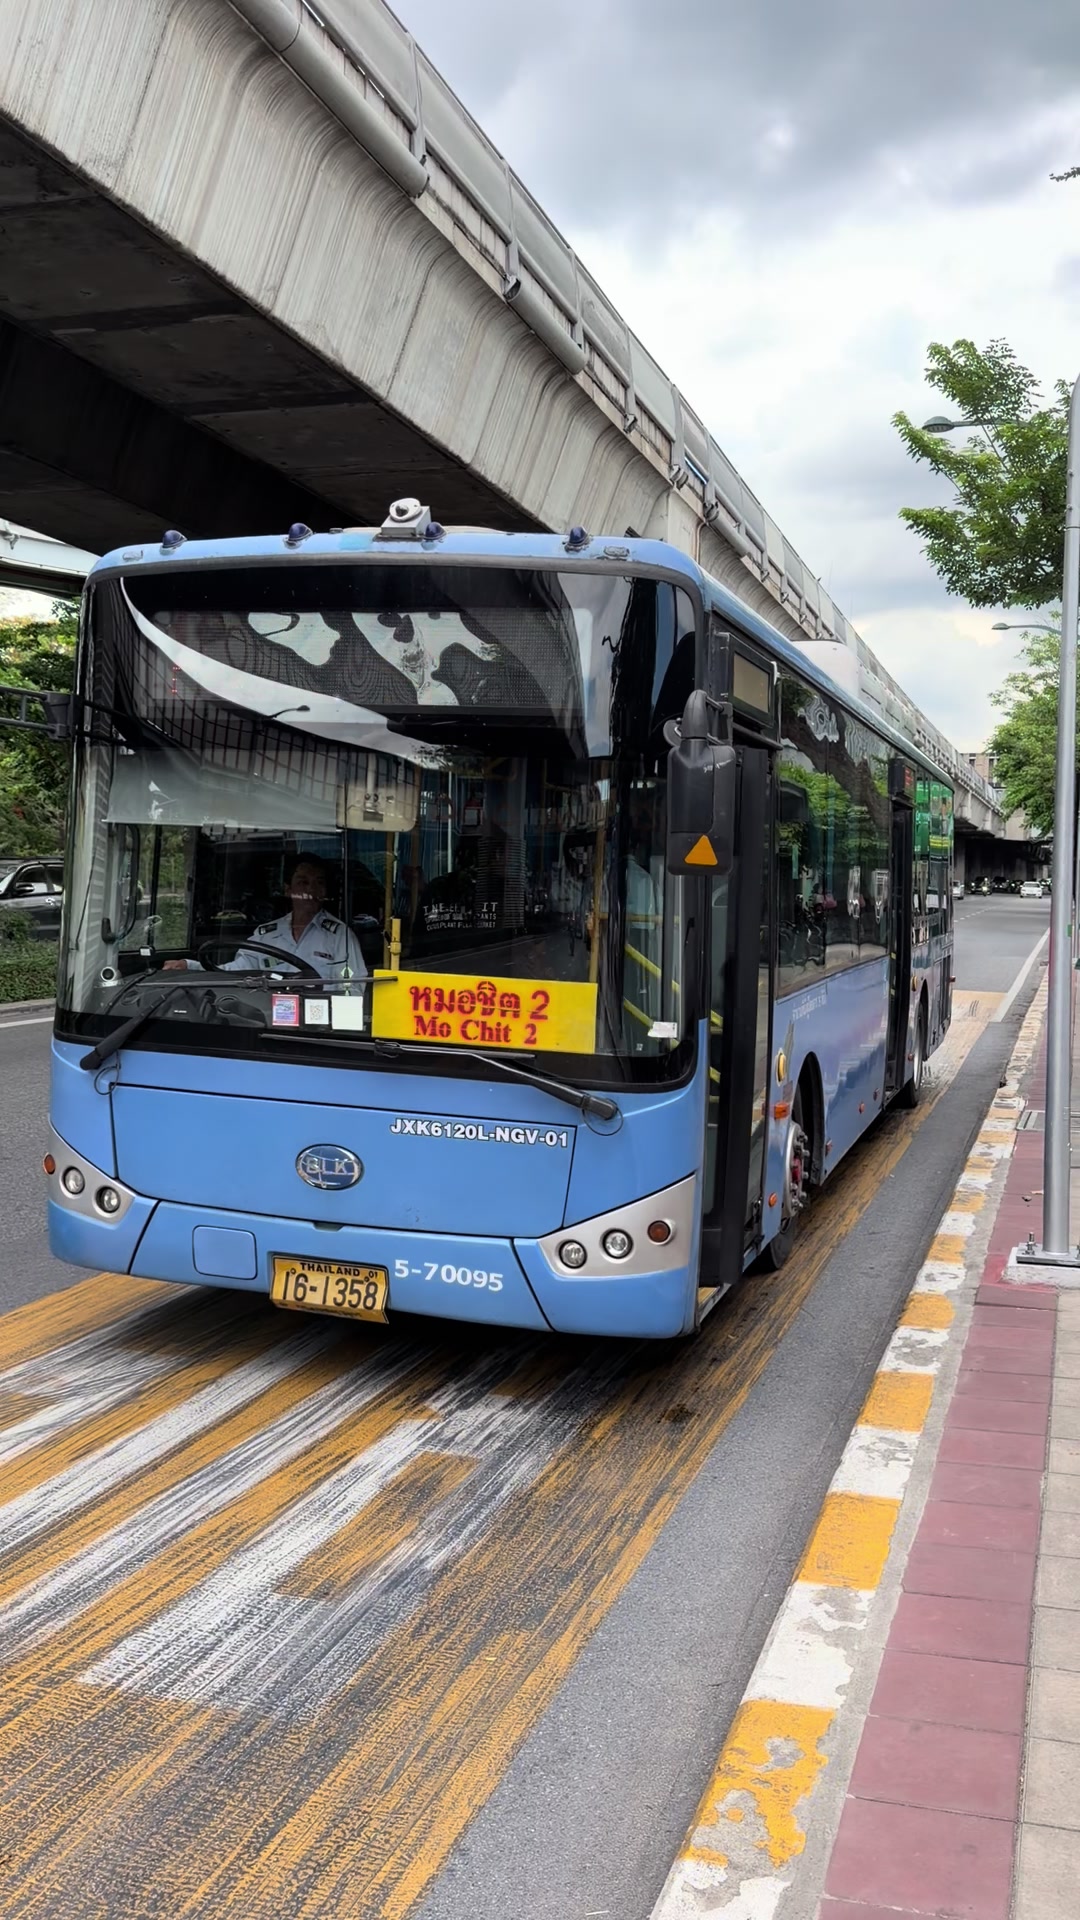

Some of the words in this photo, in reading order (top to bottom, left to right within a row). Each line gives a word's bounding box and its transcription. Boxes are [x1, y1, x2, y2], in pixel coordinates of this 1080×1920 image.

[409, 981, 521, 1018] หมอชิต
[530, 990, 550, 1020] 2
[413, 1015, 452, 1038] Mo
[460, 1019, 512, 1043] Chit
[524, 1023, 537, 1045] 2
[390, 1118, 568, 1148] JXK6120L-NGV-01
[299, 1262, 360, 1277] THAILAND
[394, 1259, 504, 1292] 5-70095
[282, 1270, 379, 1311] 16-1358
